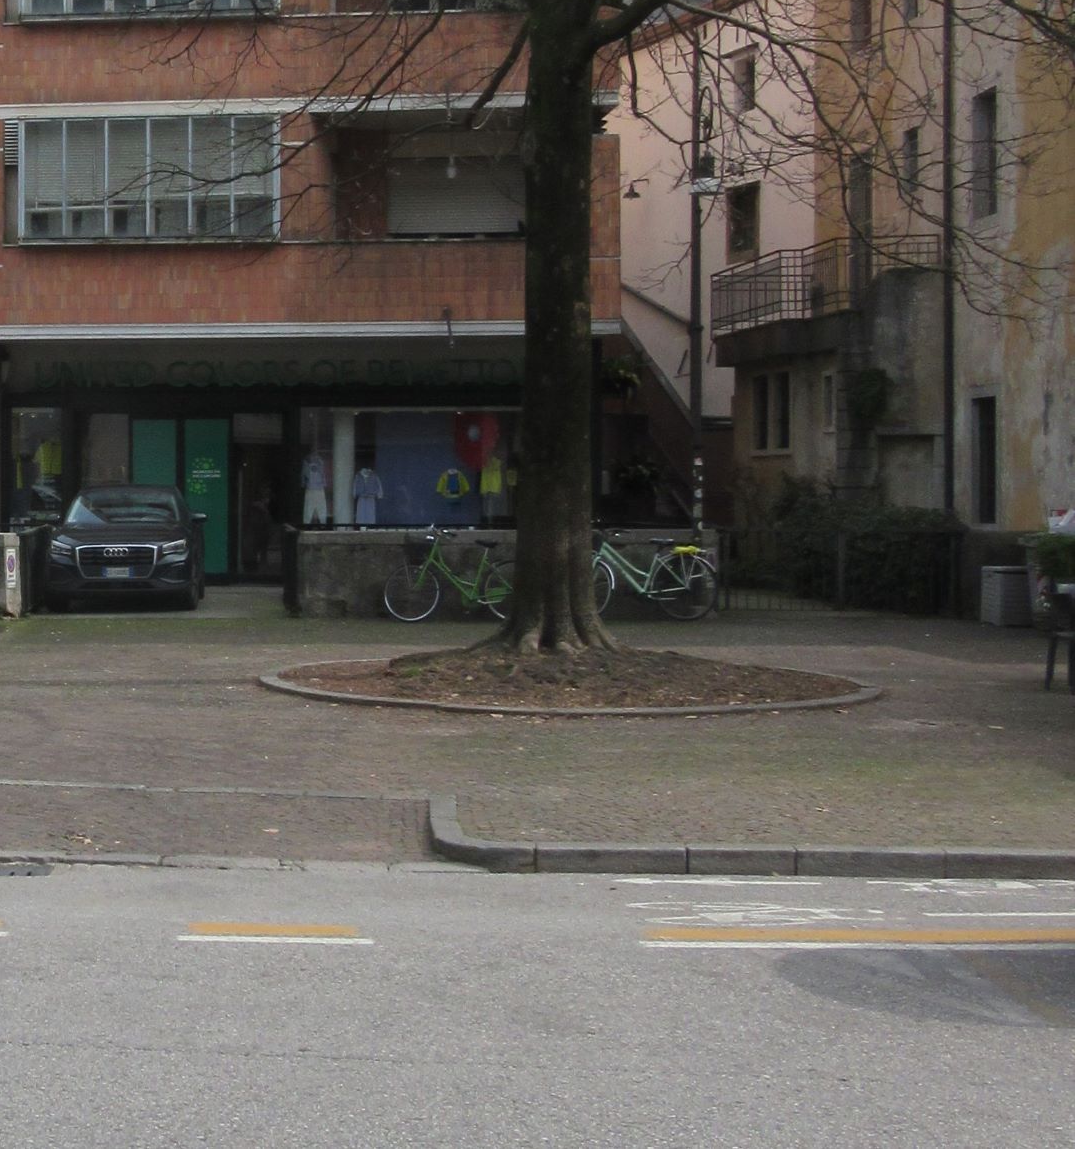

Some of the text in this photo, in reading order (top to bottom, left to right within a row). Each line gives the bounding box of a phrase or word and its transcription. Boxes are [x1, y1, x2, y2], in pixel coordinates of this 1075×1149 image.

[35, 357, 525, 388] UNITED COLORS OF BENETTO
